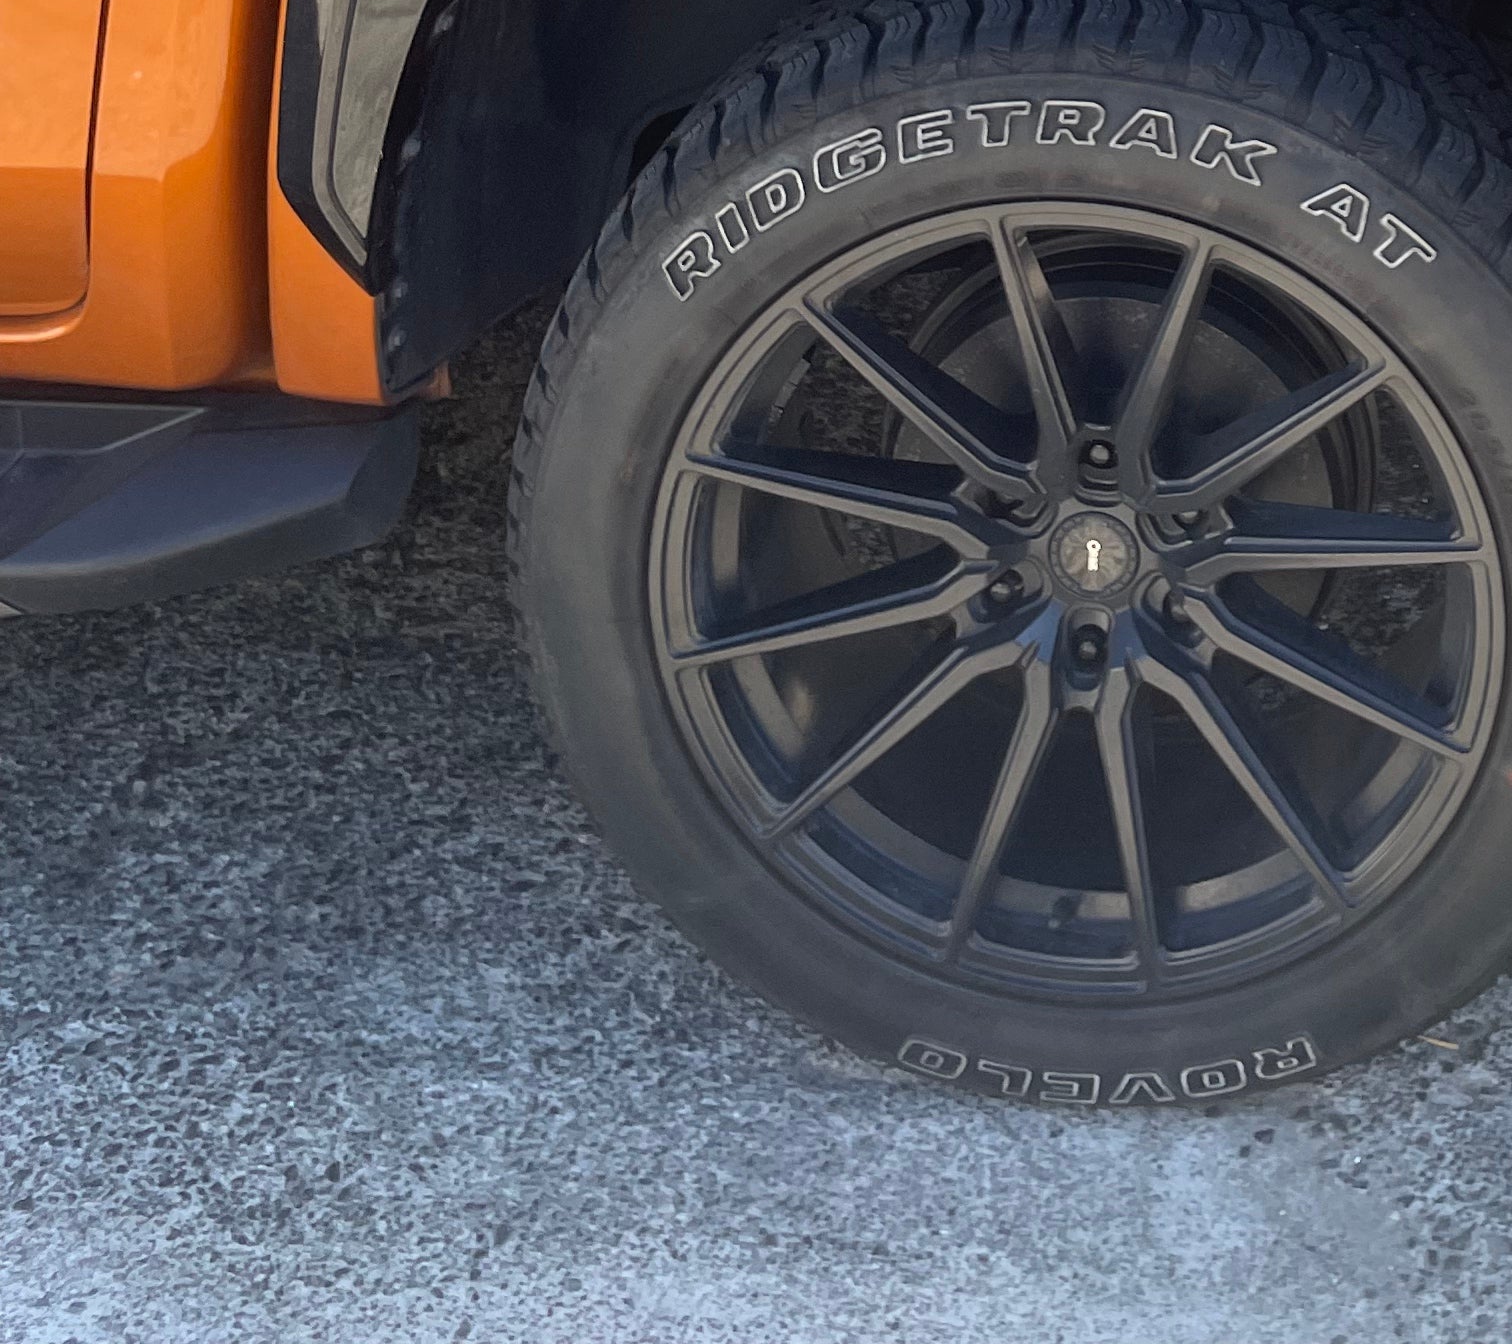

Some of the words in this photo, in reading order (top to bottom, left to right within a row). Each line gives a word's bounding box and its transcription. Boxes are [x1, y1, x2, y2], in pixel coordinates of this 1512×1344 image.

[661, 100, 1277, 302] RIDGETRAK
[1301, 184, 1437, 270] AT
[898, 1036, 1317, 1104] ROVELO
